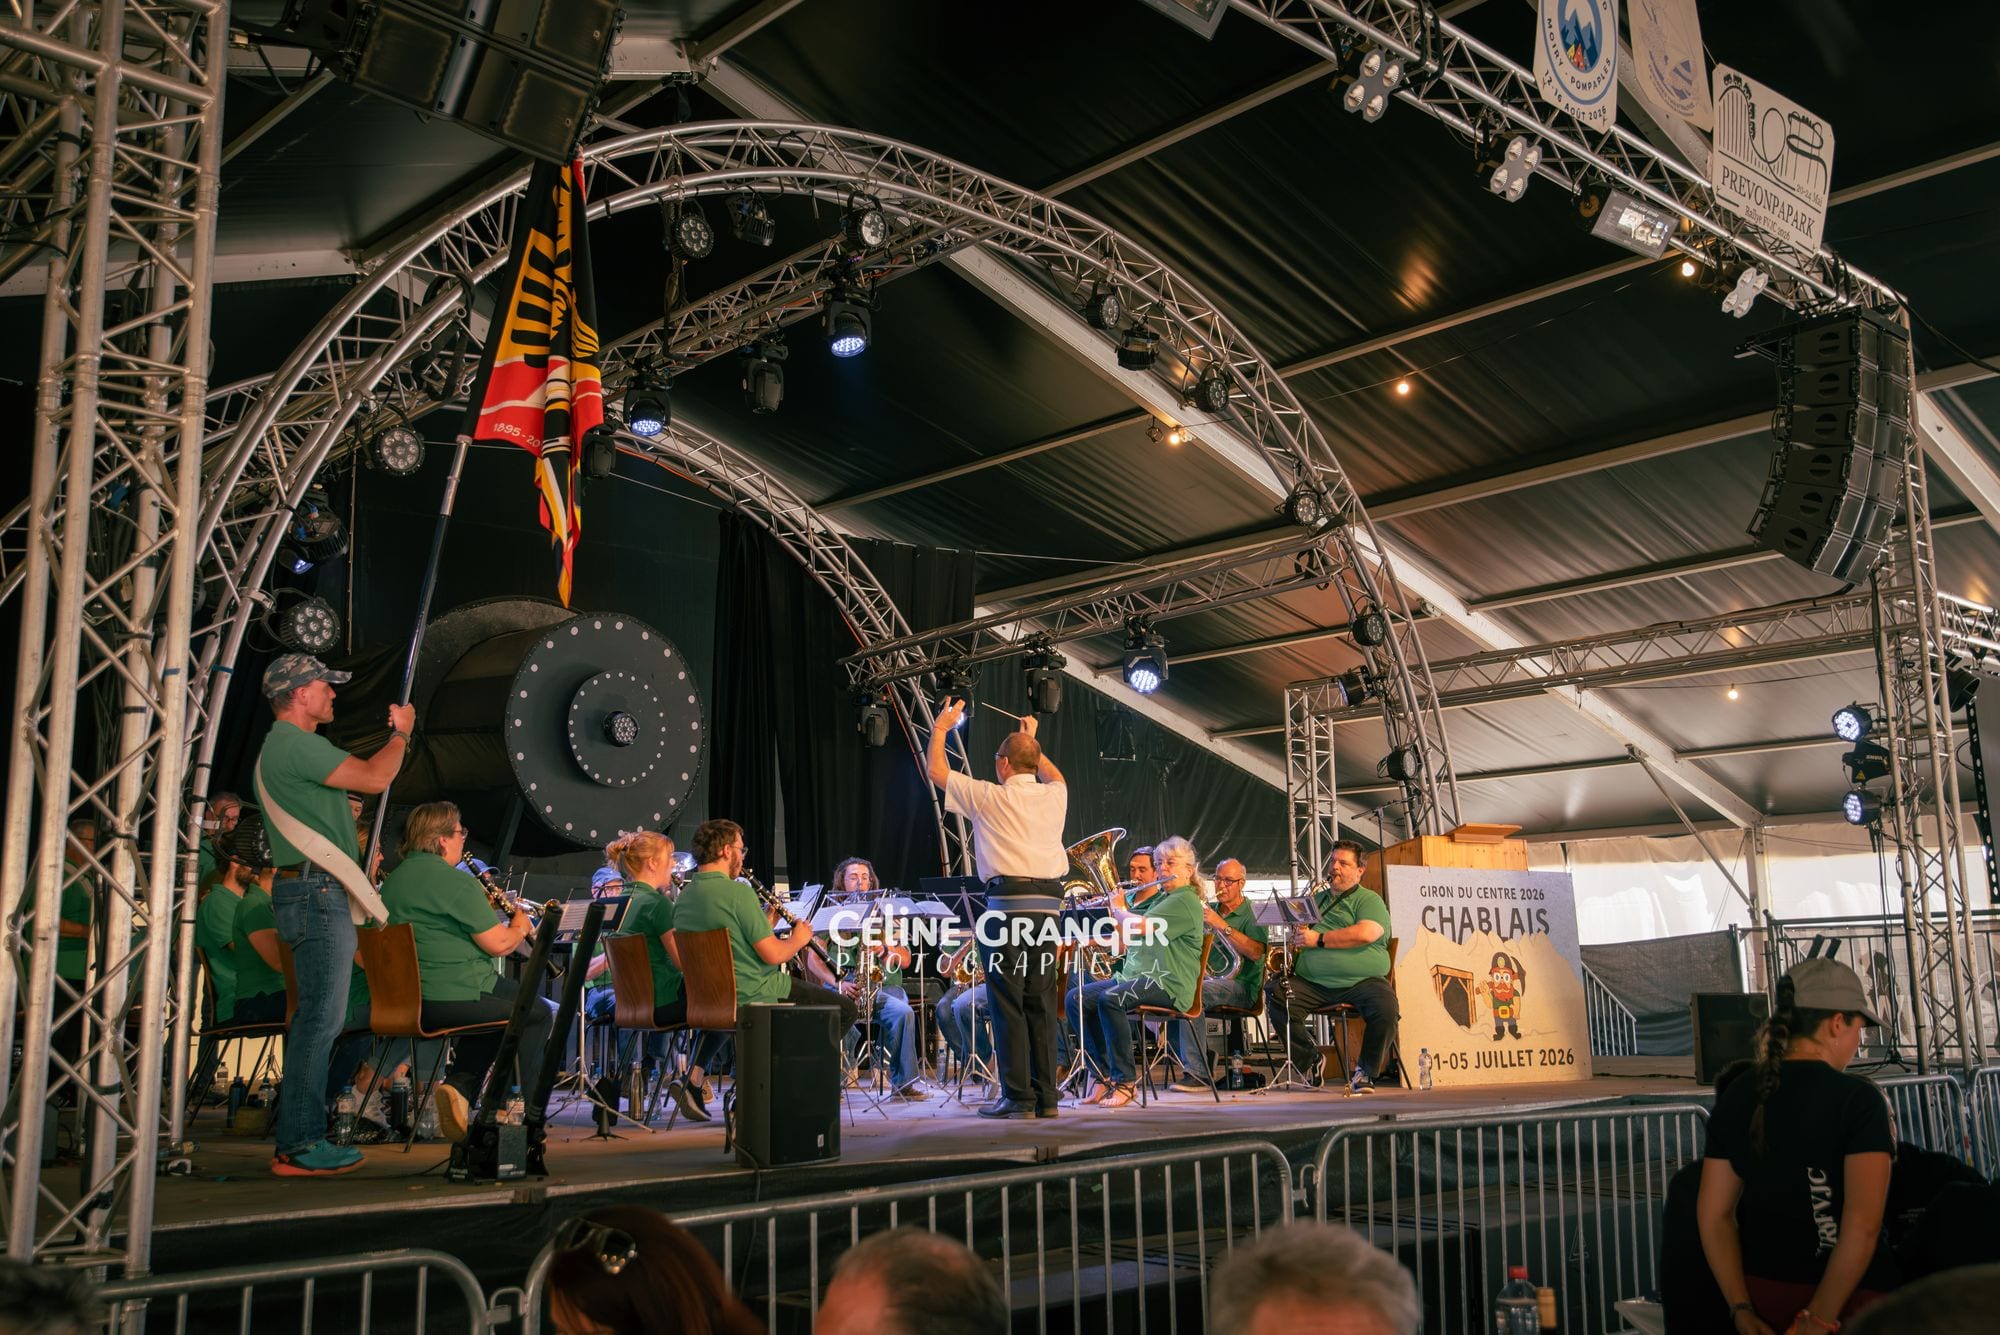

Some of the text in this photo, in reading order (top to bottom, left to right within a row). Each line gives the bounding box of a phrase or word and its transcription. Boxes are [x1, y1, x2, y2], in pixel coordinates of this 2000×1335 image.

[1546, 18, 1564, 67] MOIRY
[1570, 58, 1611, 91] POMPAPLES
[1564, 103, 1586, 121] AOÛT
[1588, 105, 1607, 121] 2026
[1721, 165, 1815, 239] PREVONPAPARK
[1796, 184, 1823, 207] 20-24 Mai
[1744, 205, 1763, 224] Rallye
[1777, 227, 1790, 240] 2026
[1420, 885, 1545, 901] GIRON DU CENTRE 2026
[1421, 905, 1550, 945] CHABLAIS
[1474, 1049, 1535, 1069] JUILLET
[1539, 1048, 1575, 1067] 2026
